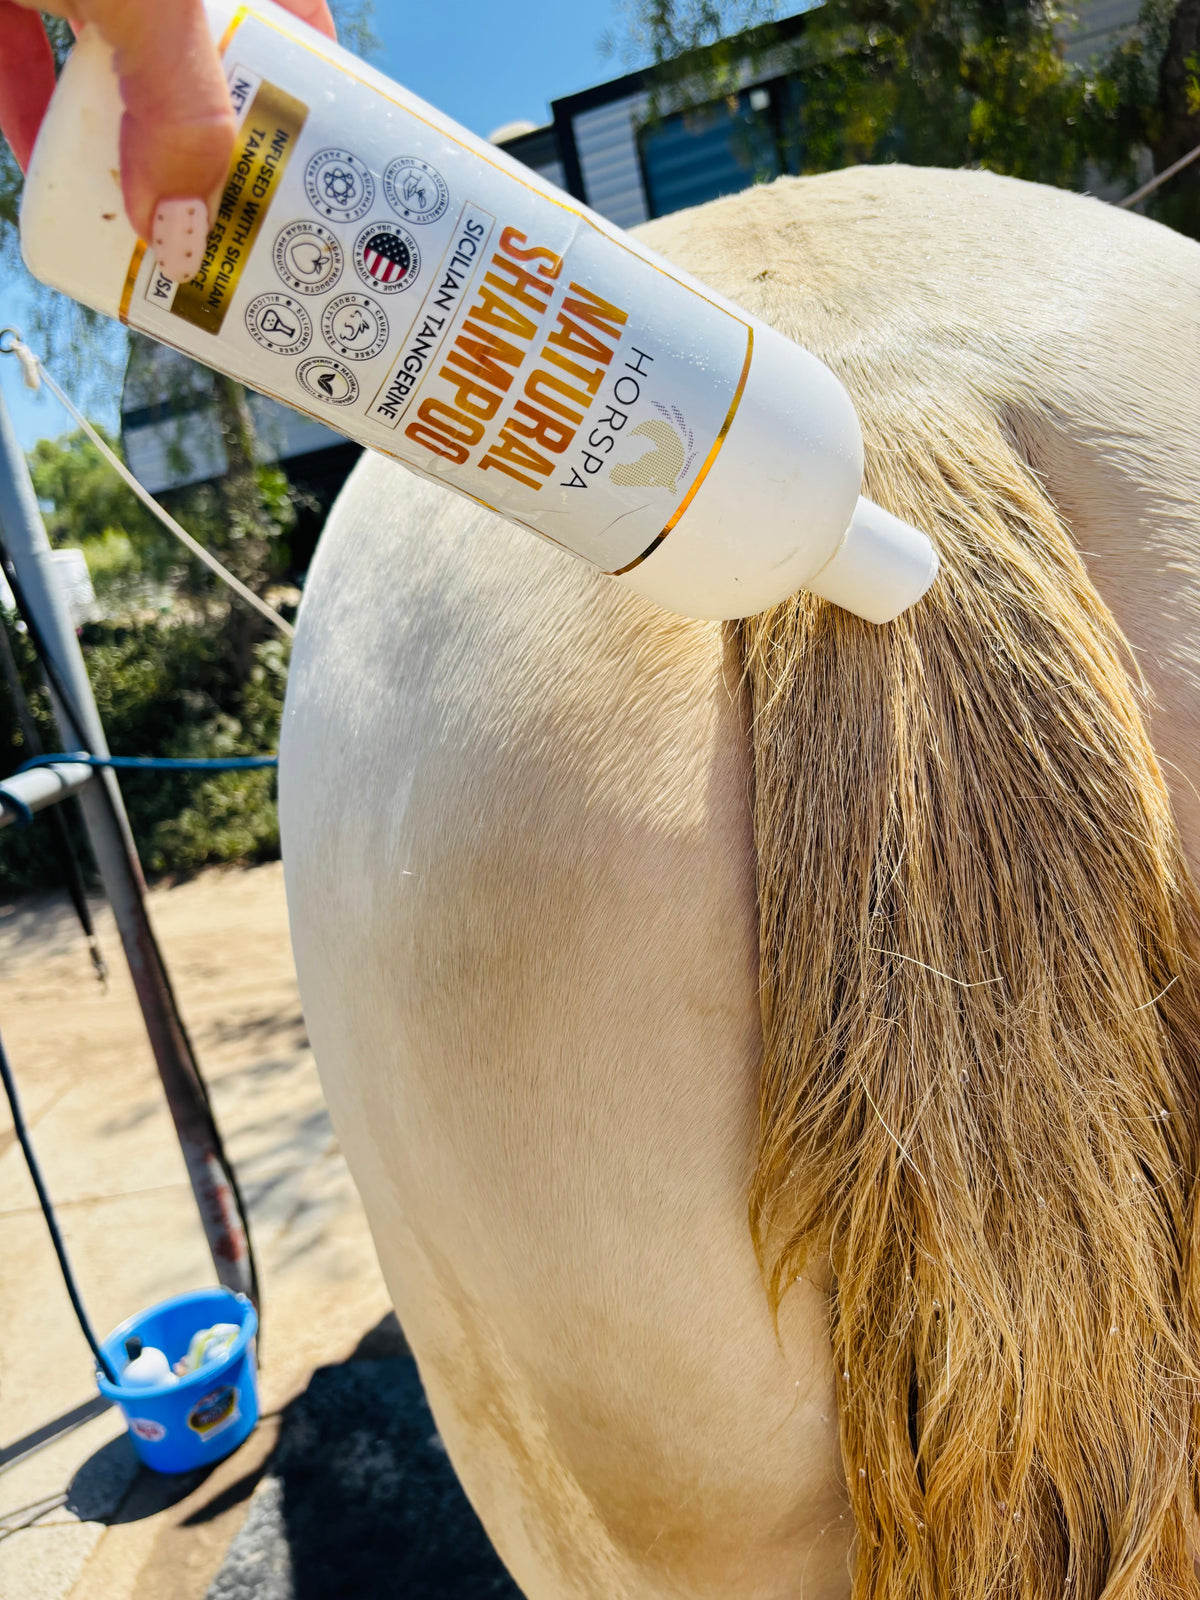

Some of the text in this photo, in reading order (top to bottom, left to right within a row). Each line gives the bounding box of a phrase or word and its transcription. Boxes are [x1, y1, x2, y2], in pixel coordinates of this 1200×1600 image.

[233, 77, 251, 115] NET
[217, 128, 266, 222] TANGERINE
[416, 173, 446, 222] SUSTAINABILITY
[207, 128, 289, 309] INFUSED WITH SICILIAN
[358, 227, 376, 250] OWNED
[276, 224, 313, 282] VEGAN PRODUCTS
[305, 235, 341, 293] VEGAN PRODUCTS
[405, 236, 416, 252] USA
[408, 253, 419, 279] OWNED
[357, 259, 371, 281] MADE
[383, 283, 404, 292] MADE
[248, 296, 280, 341] SILICONE-FREE
[279, 308, 310, 353] SILICONE-FREE
[324, 296, 357, 346] CRUELTY FREE
[355, 310, 386, 359] CRUELTY FREE
[377, 219, 484, 420] SICILIAN TANGERINE
[404, 226, 564, 465] SHAMPOO
[477, 281, 629, 491] NATURAL
[560, 346, 654, 489] HORSPA
